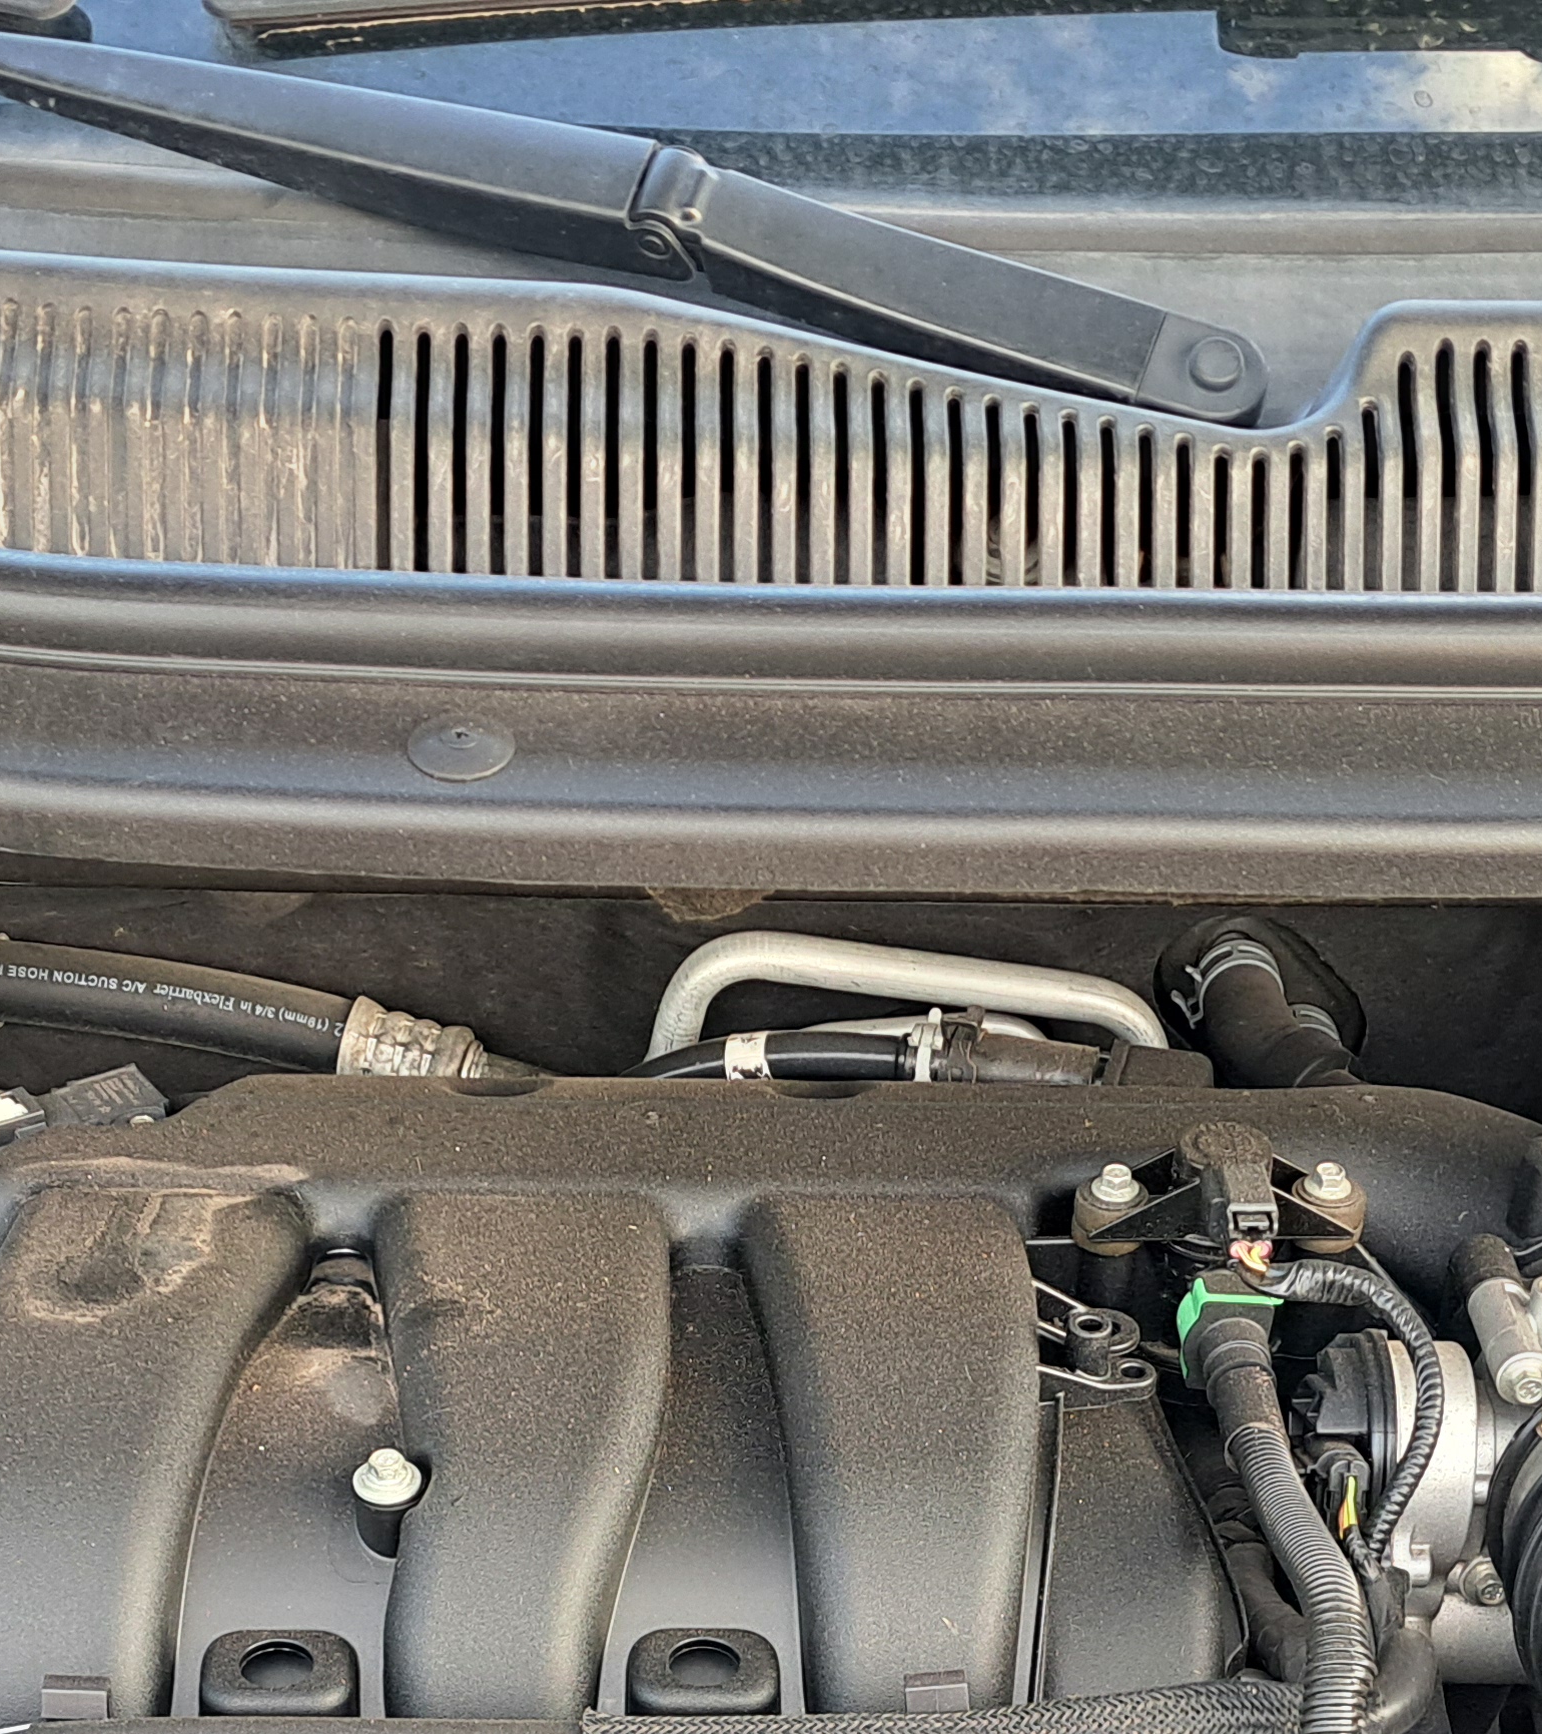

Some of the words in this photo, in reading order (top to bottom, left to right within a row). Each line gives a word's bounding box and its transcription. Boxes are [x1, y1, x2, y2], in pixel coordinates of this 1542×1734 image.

[7, 965, 48, 981] HOSE
[52, 971, 119, 990] SUCTION
[121, 979, 146, 995] A/C
[153, 983, 235, 1012] Flexbarrier
[255, 1003, 275, 1019] 3/4
